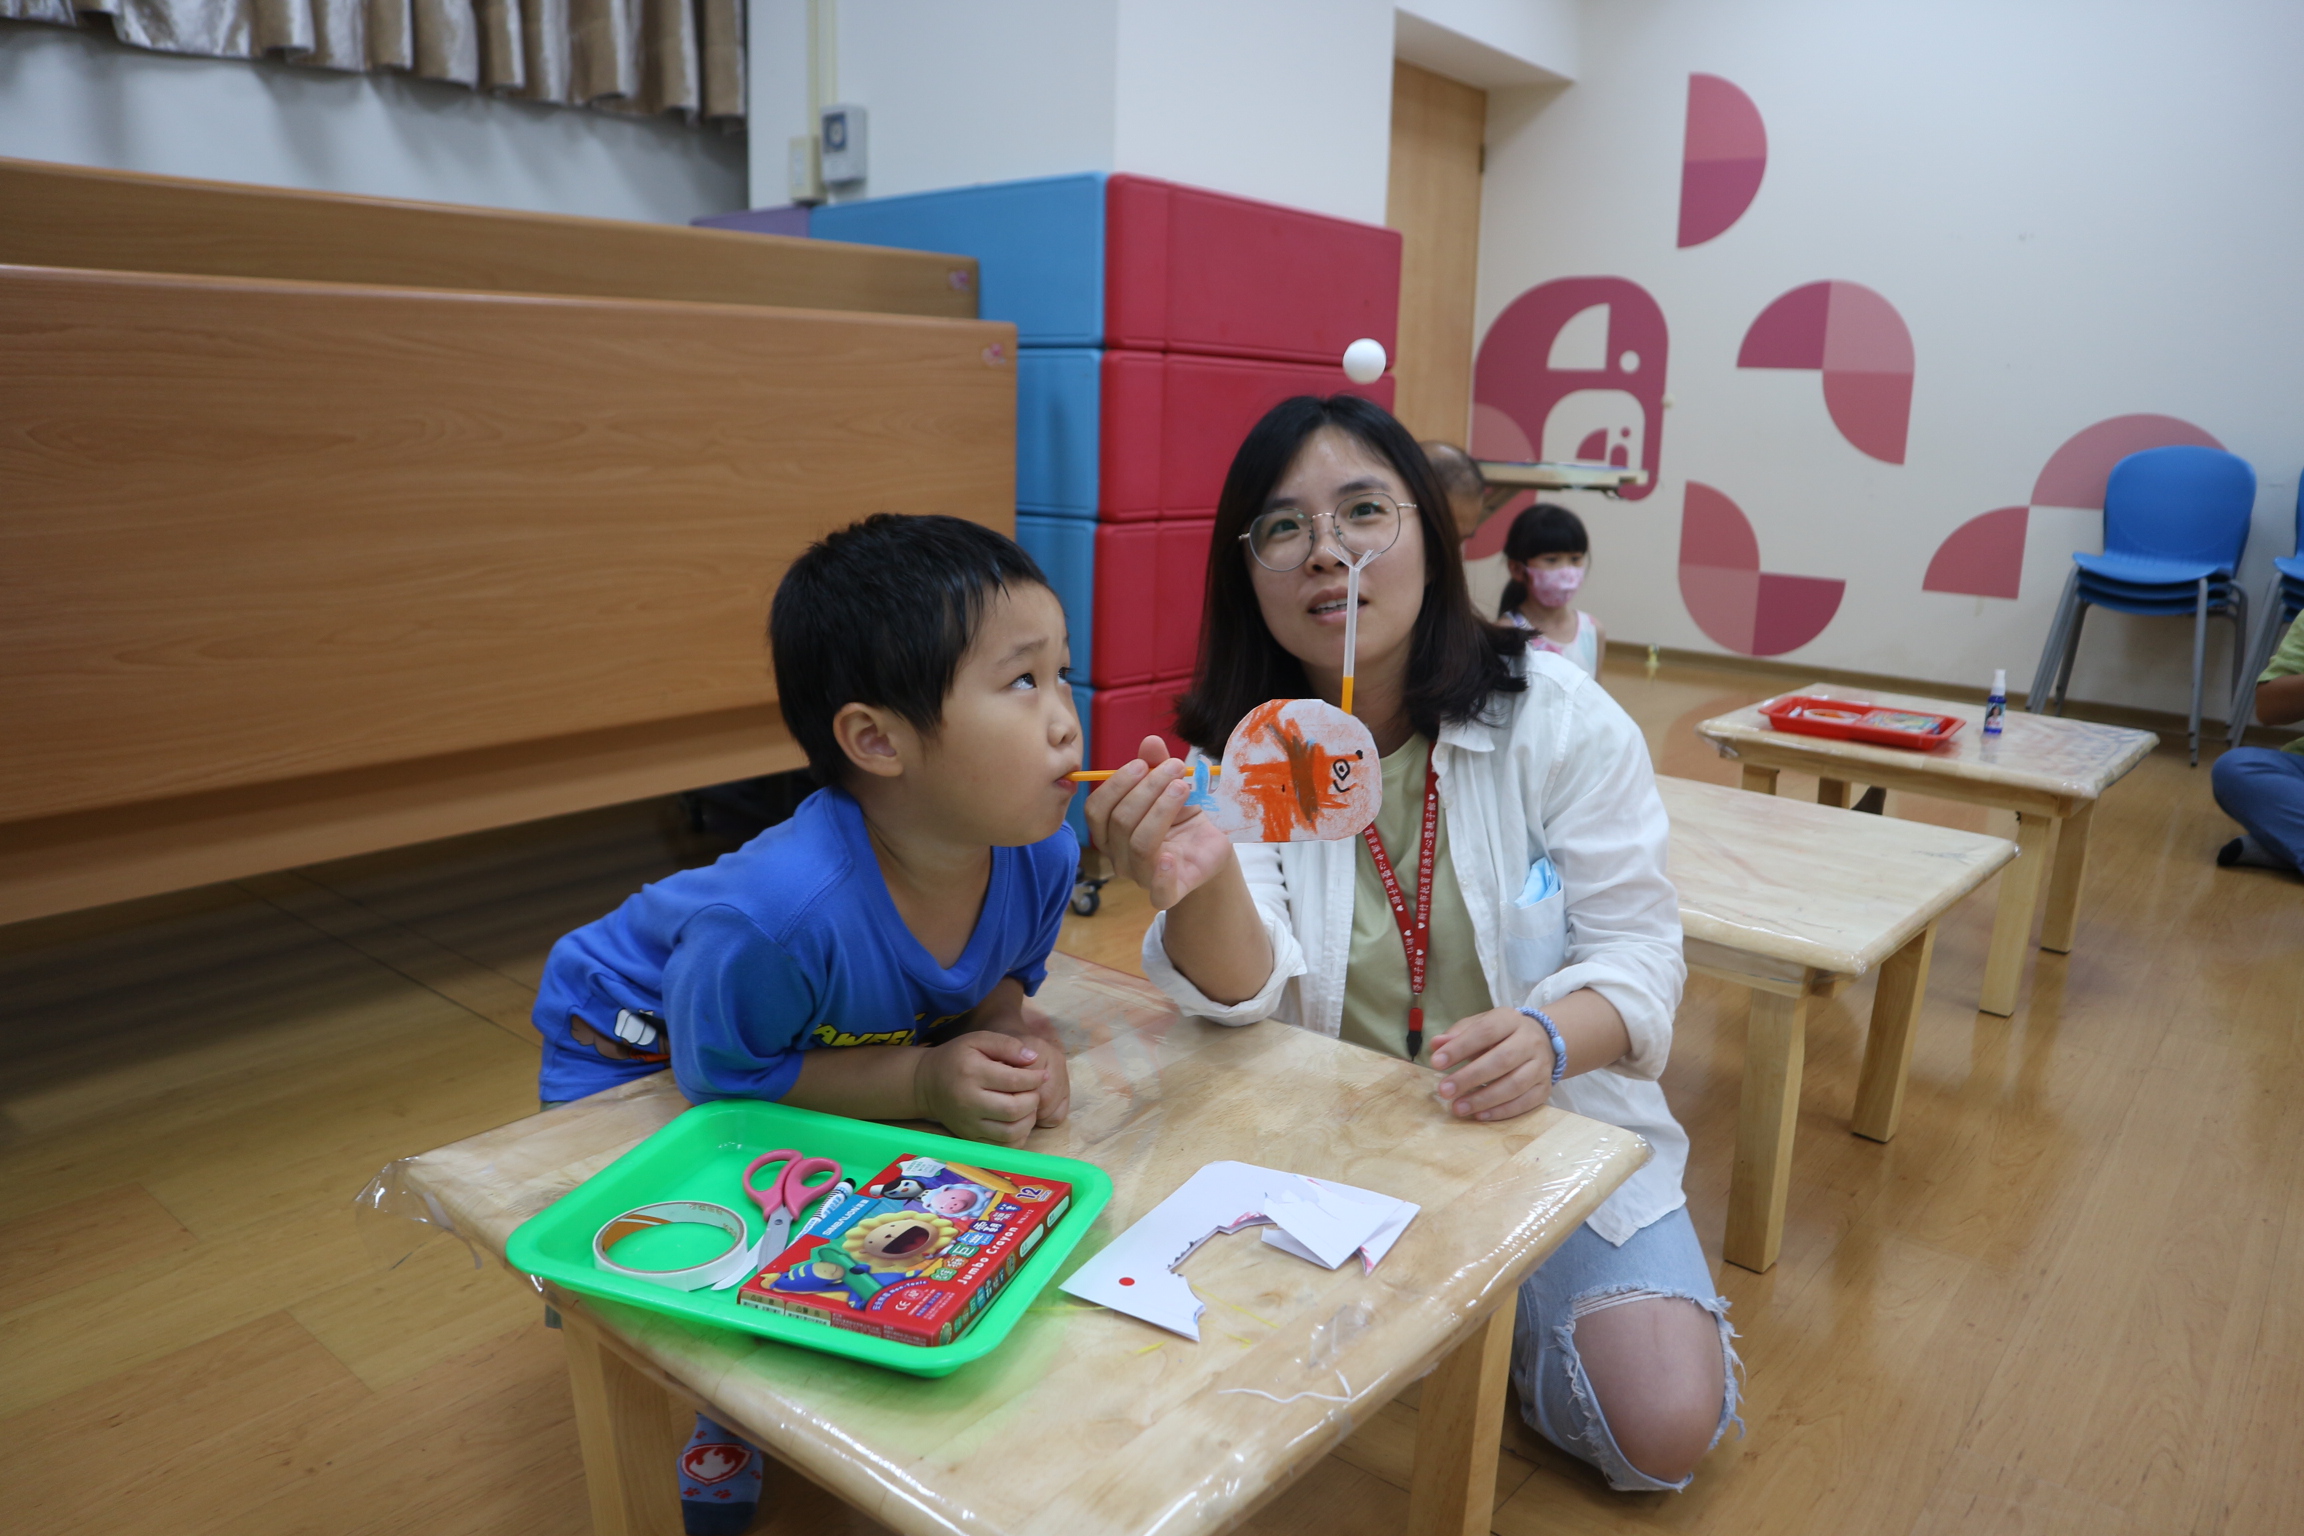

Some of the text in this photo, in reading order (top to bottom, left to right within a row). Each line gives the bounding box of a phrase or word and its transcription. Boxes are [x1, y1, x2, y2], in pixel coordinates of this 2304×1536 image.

[1016, 1187, 1042, 1199] 12
[957, 1226, 1019, 1285] Jumbo Crayon
